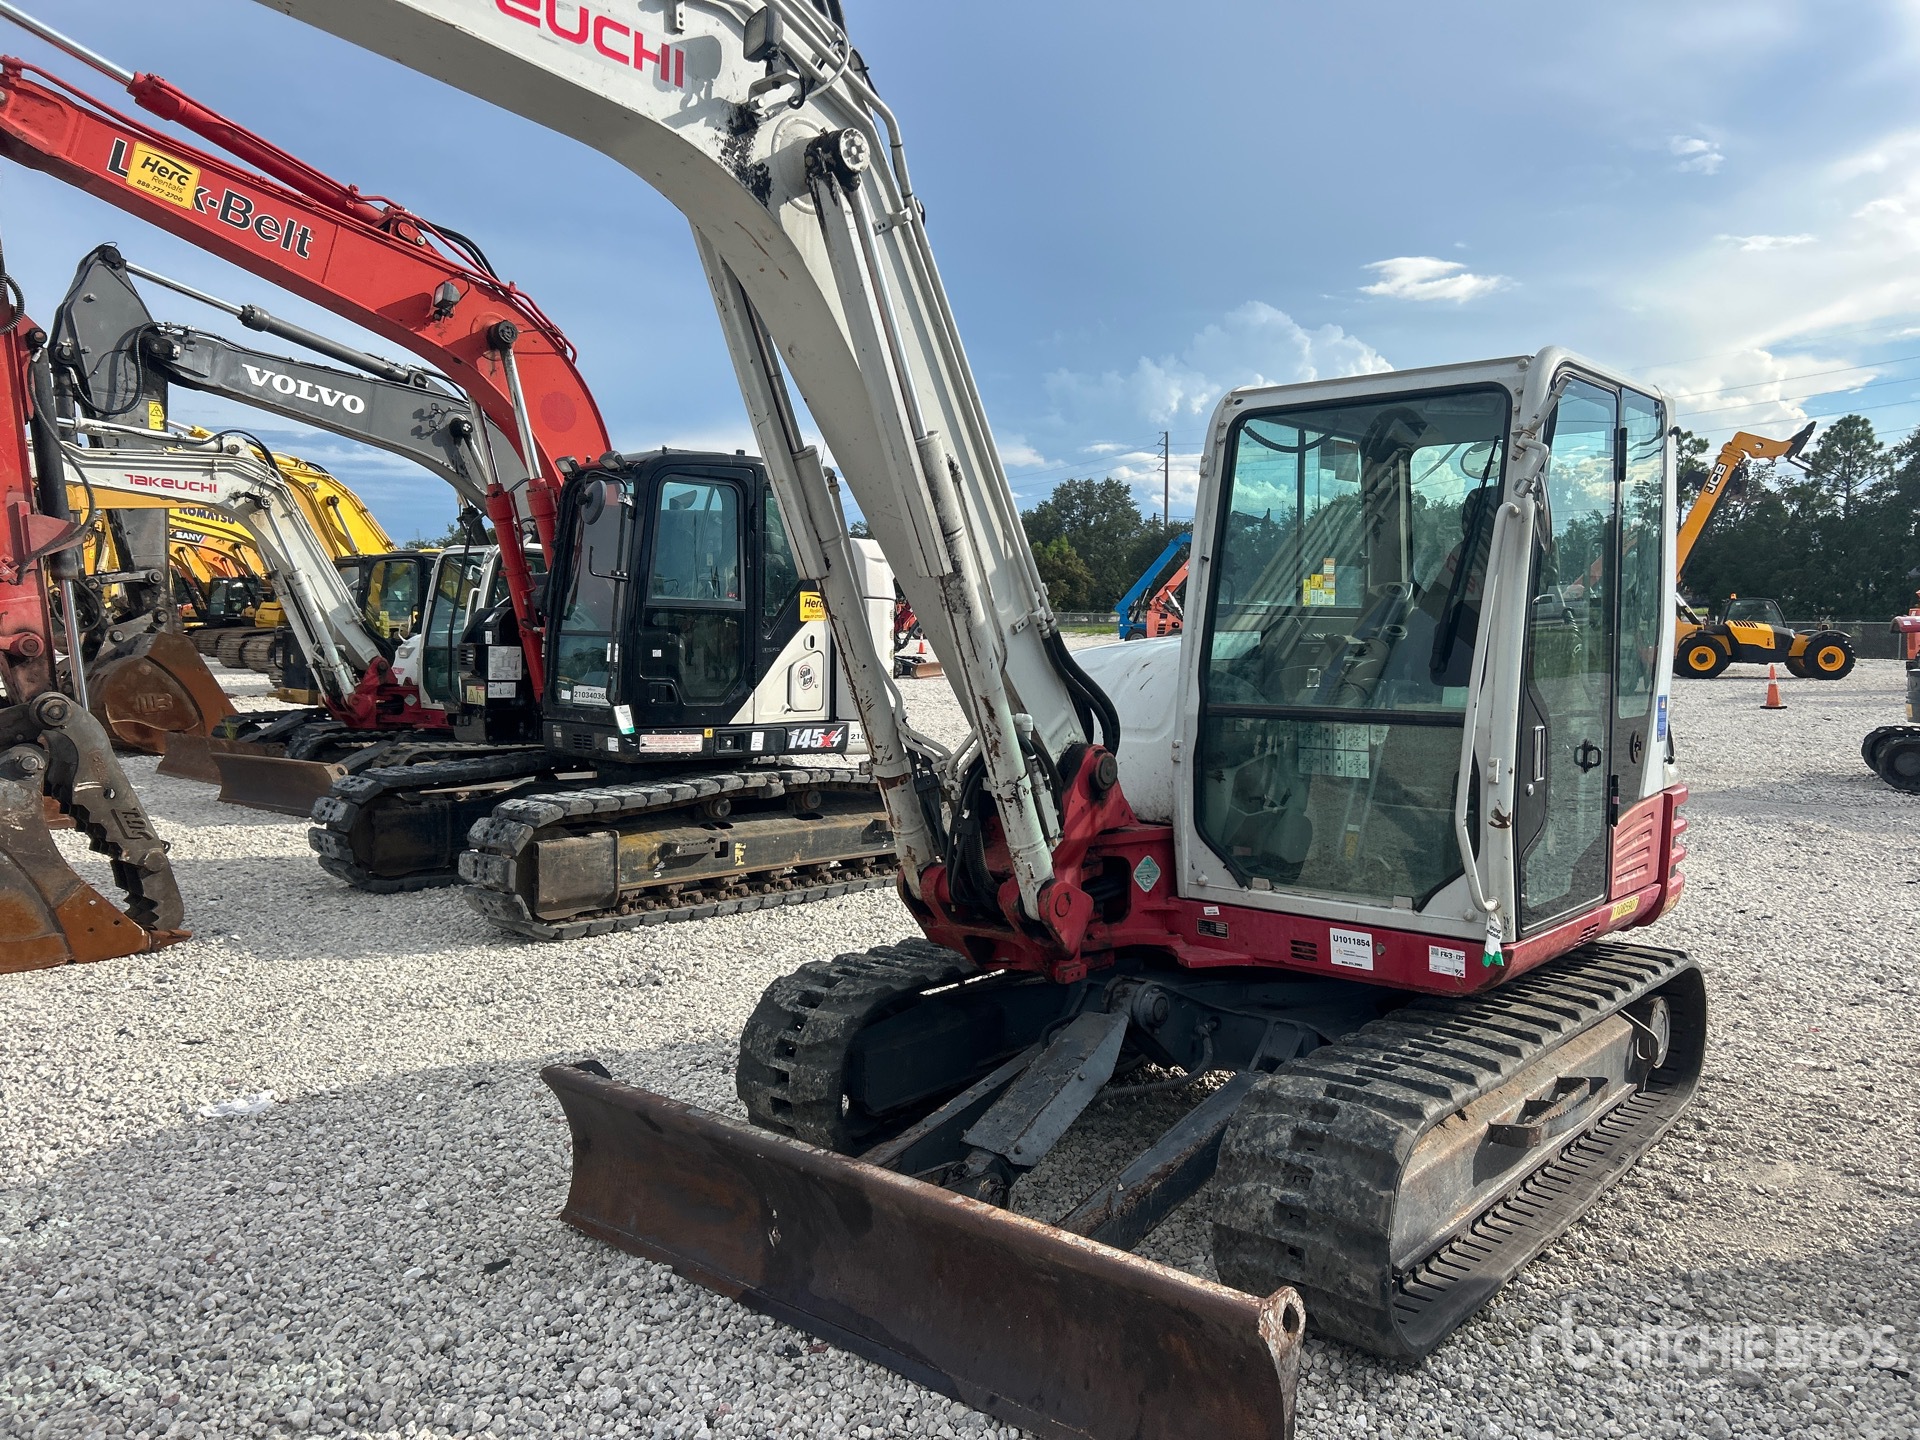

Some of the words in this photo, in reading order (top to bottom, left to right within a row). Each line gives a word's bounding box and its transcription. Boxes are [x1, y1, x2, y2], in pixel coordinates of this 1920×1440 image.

[140, 156, 190, 187] Herc
[136, 179, 184, 203] 888-777-2700
[151, 175, 185, 194] Rentals
[242, 363, 366, 415] VOLVO
[1707, 463, 1728, 495] JCB
[175, 531, 202, 544] SANY
[1332, 934, 1371, 948] U1011854
